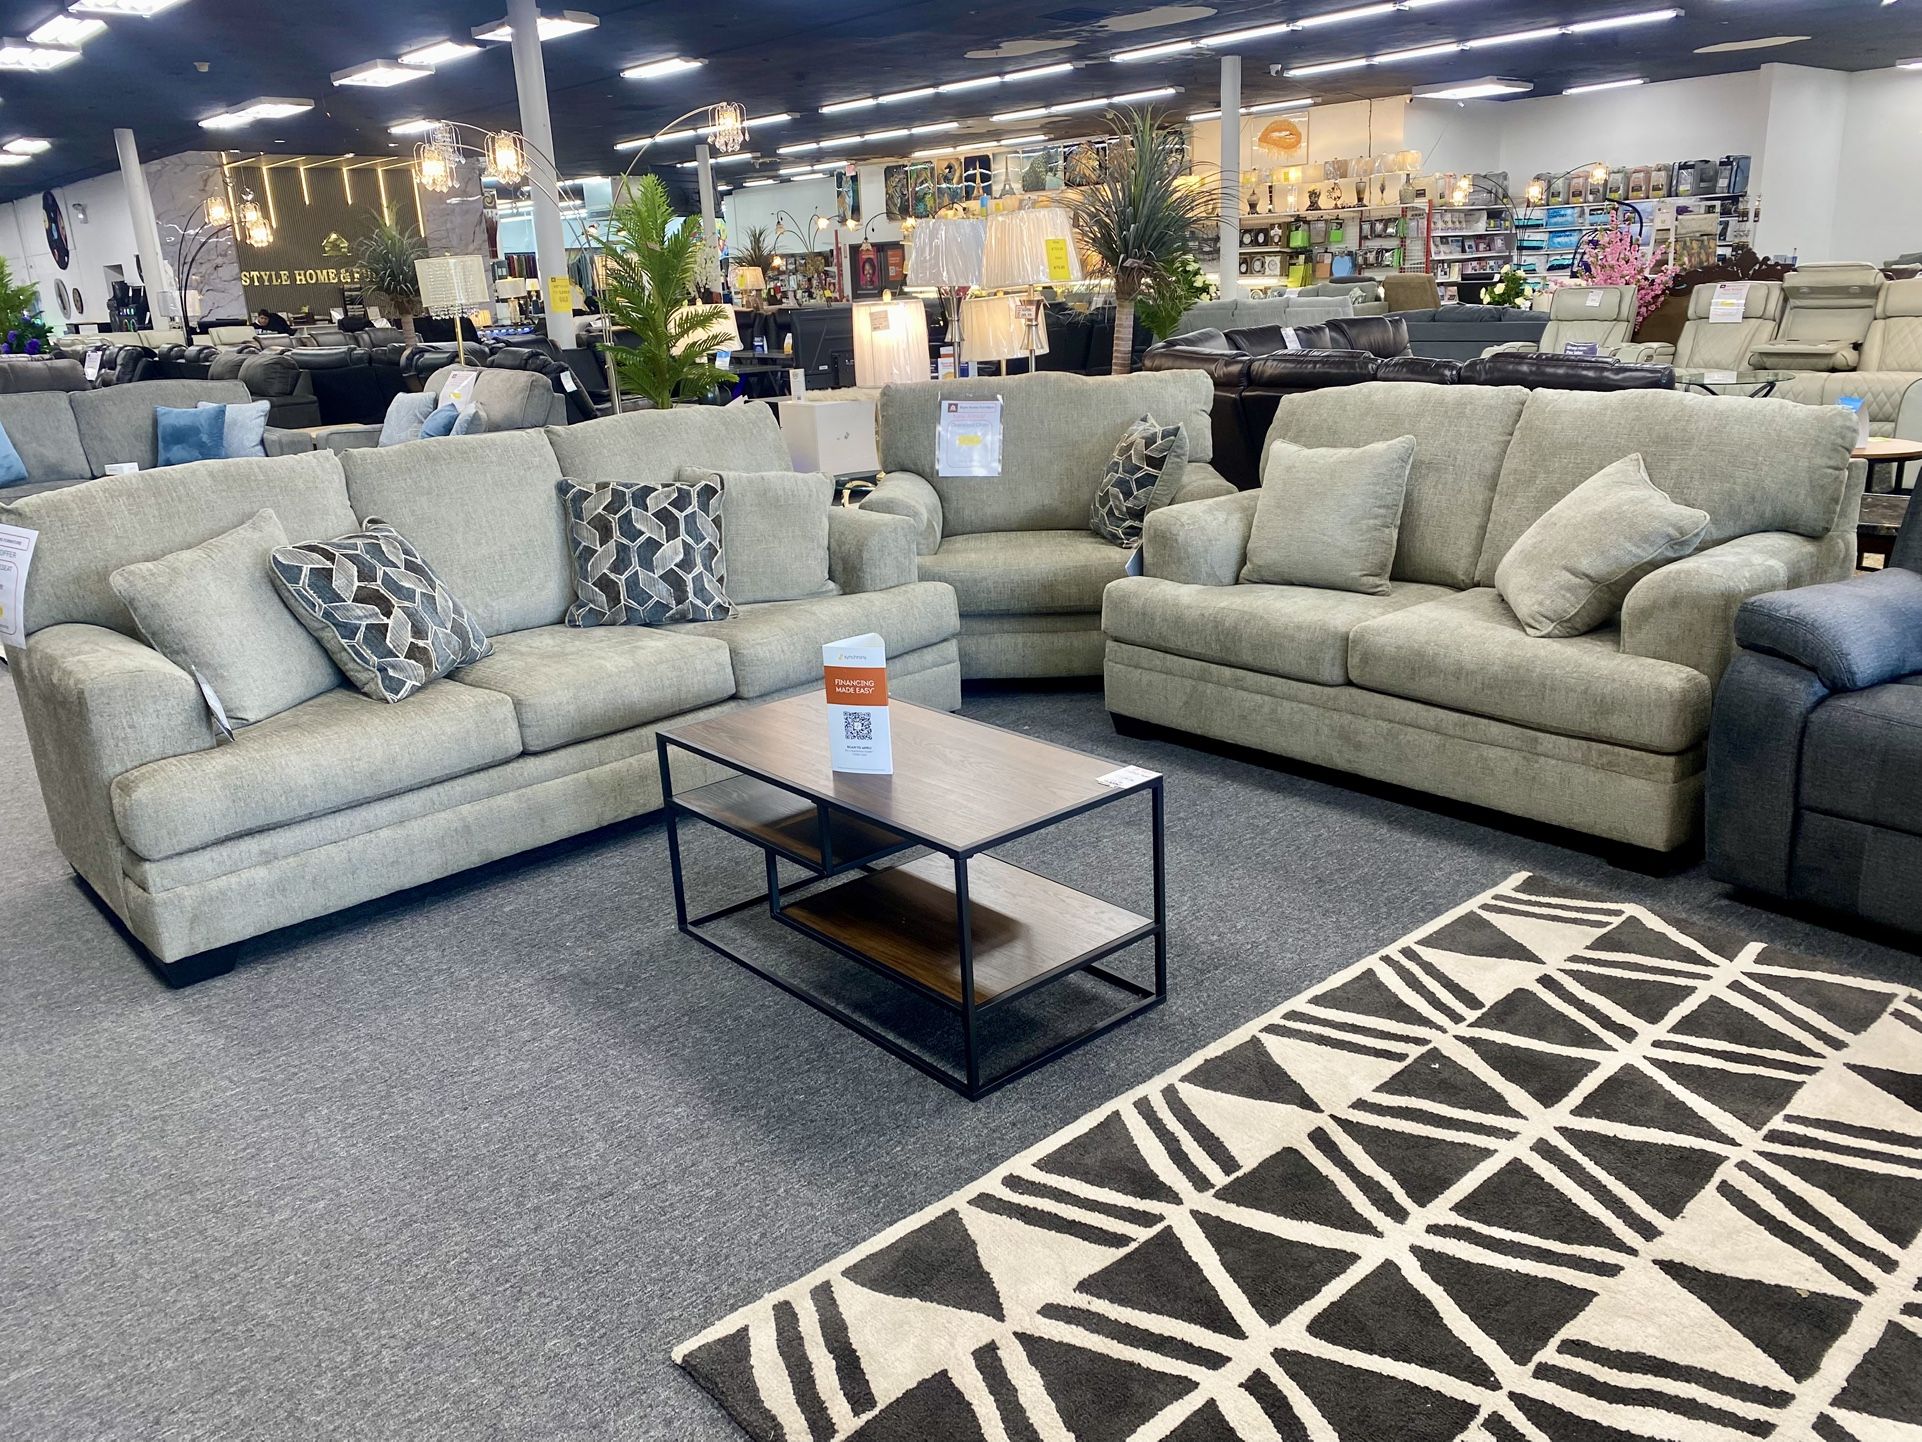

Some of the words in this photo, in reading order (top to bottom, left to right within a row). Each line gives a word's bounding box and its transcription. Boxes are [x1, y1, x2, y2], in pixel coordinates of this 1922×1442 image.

[241, 270, 290, 286] STYLE
[294, 268, 338, 285] HOME
[340, 268, 351, 283] &
[834, 678, 875, 688] FINANCING
